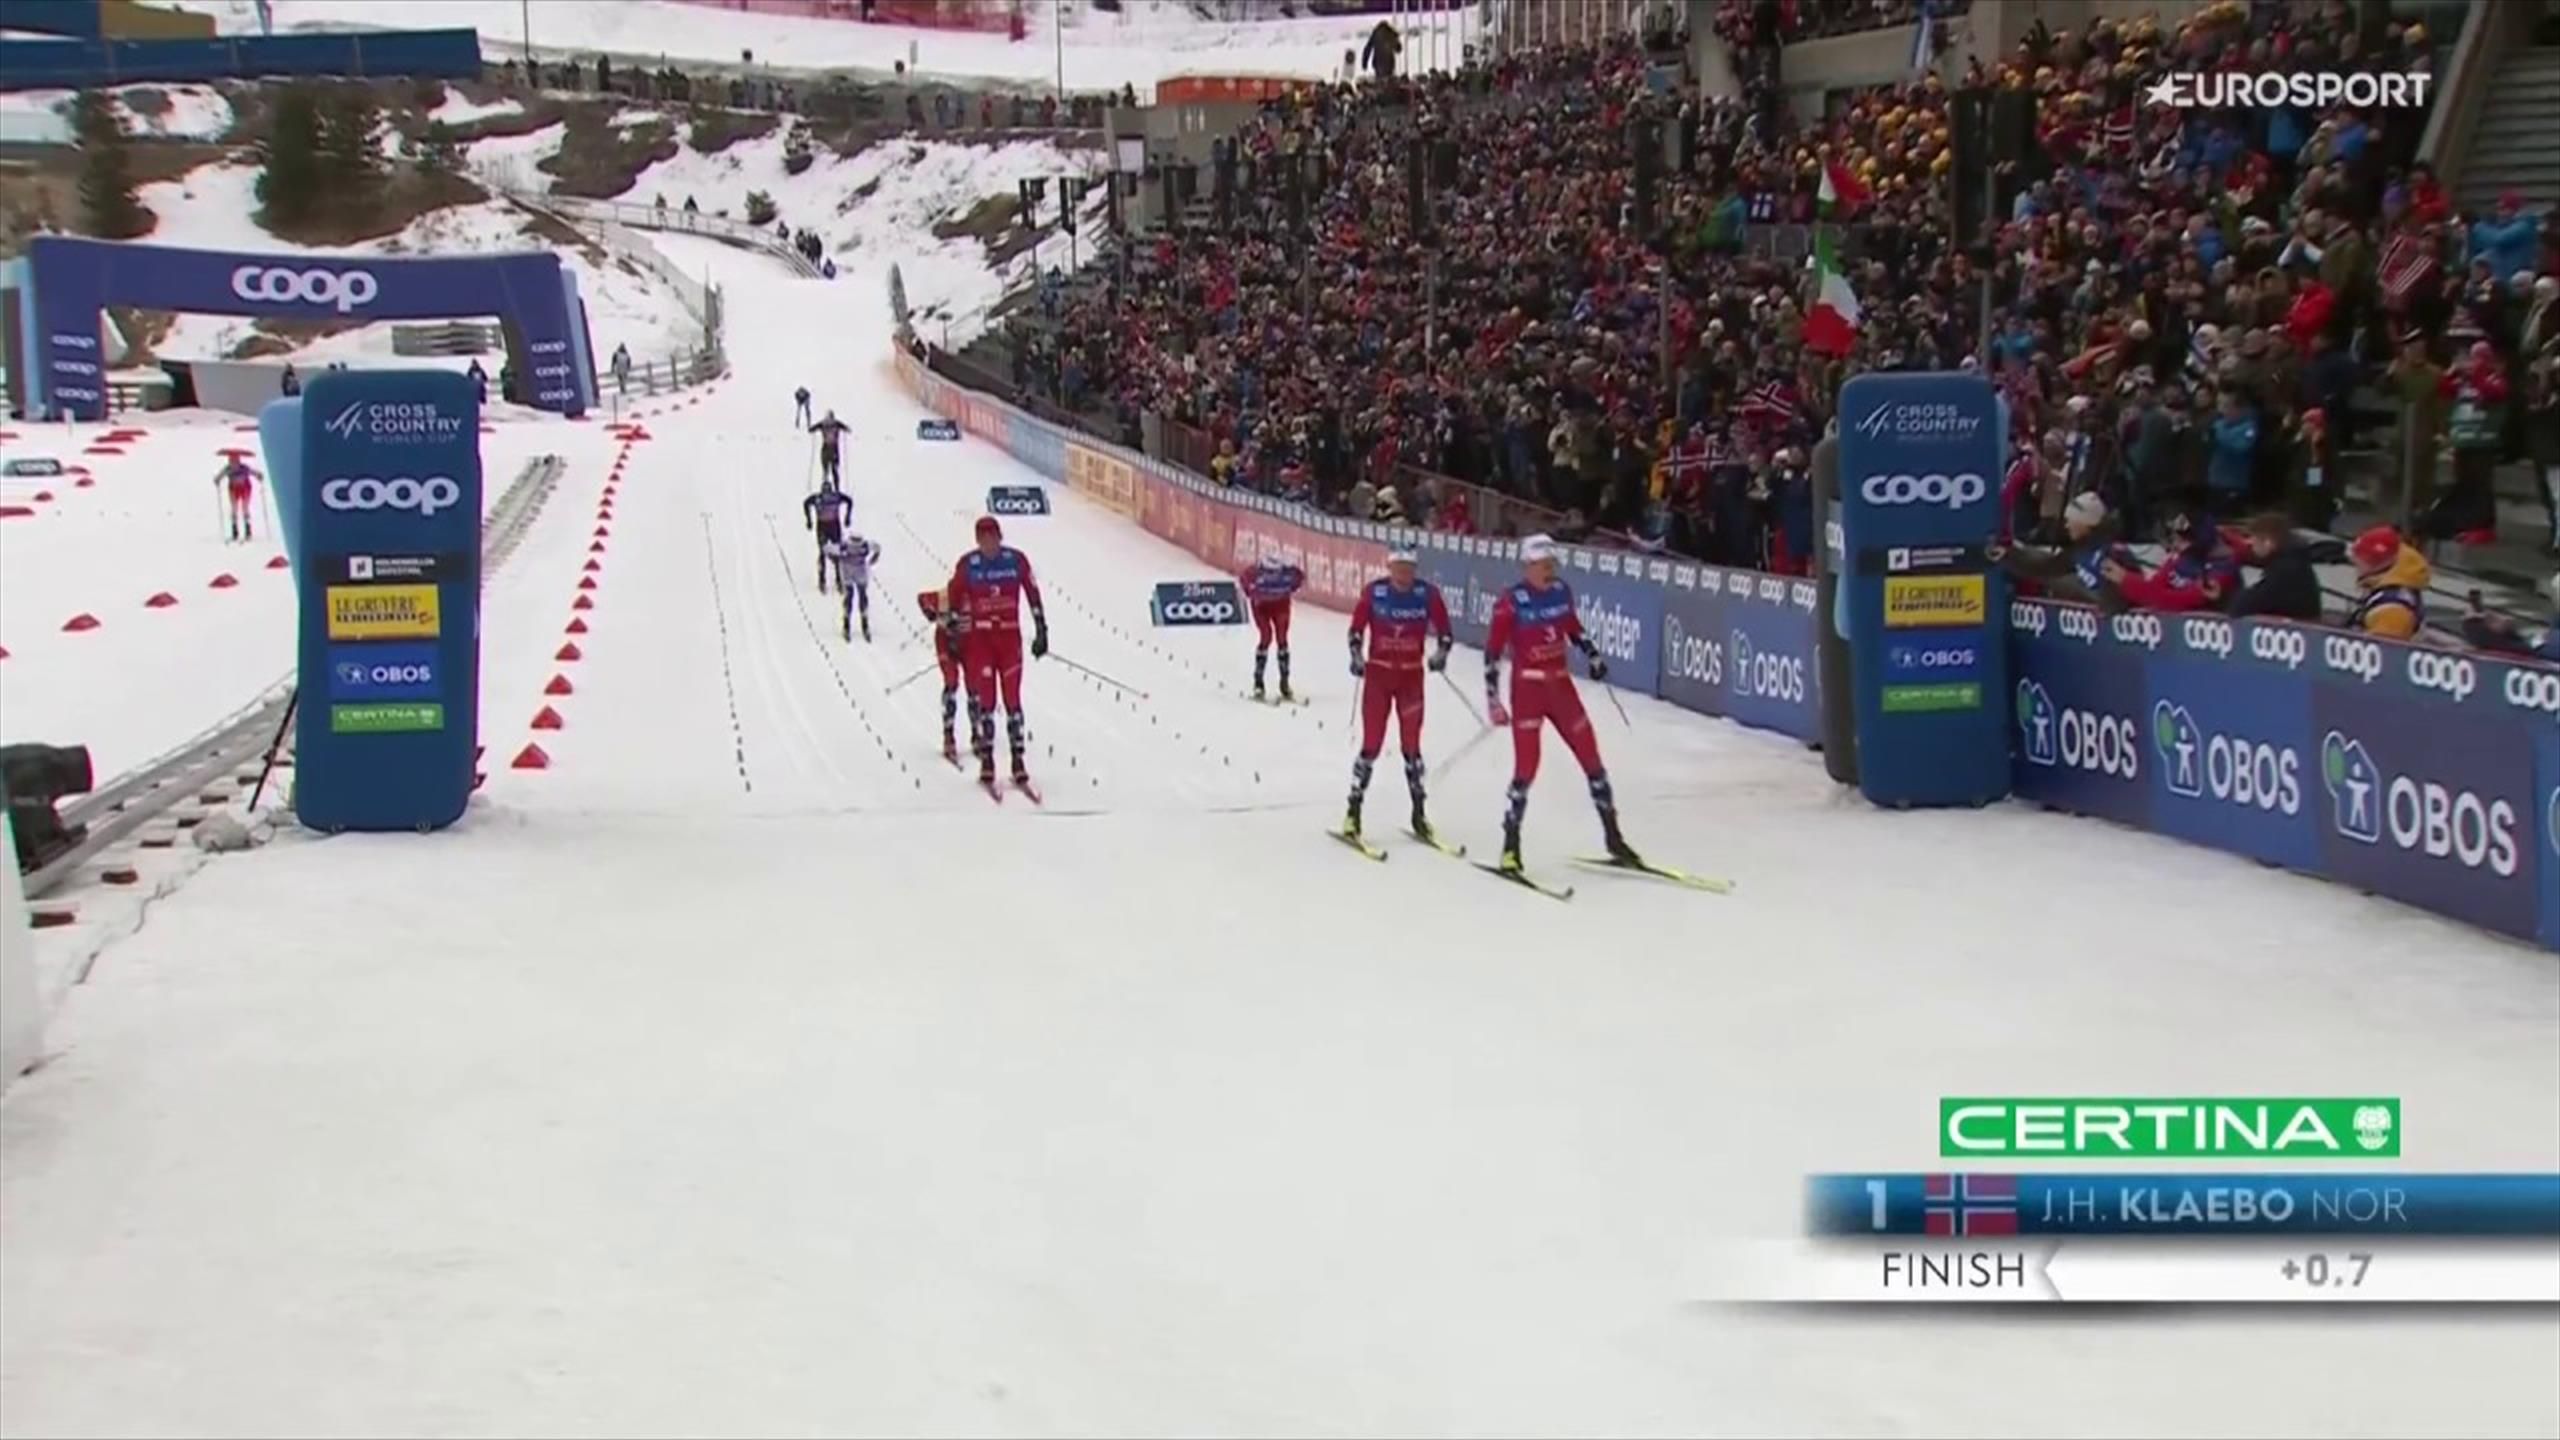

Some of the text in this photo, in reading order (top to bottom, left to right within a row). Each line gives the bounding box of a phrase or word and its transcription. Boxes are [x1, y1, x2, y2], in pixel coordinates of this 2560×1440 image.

[232, 266, 378, 312] coop
[369, 404, 437, 418] CROSS
[1896, 405, 1958, 418] CROSS
[370, 418, 461, 433] COUNTRY
[1896, 417, 1981, 432] COUNTRY
[321, 477, 460, 515] coop
[1861, 473, 1986, 509] coop
[996, 499, 1041, 515] coop
[1183, 584, 1216, 596] 25m
[1650, 561, 1671, 586] coop
[1675, 565, 1696, 591] coop
[1701, 569, 1721, 594] coop
[1728, 574, 1752, 601] coop
[1759, 579, 1784, 606] coop
[1791, 583, 1817, 613] coop
[336, 598, 350, 612] LE
[1164, 601, 1234, 622] coop
[1545, 625, 1557, 641] 3
[1683, 637, 1722, 684] OBOS
[1921, 649, 1975, 666] OBOS
[2011, 602, 2560, 713] coop coop coop coop coop coop coop coo
[371, 666, 431, 683] OBOS
[1754, 652, 1804, 703] OBOS
[339, 710, 416, 722] CERTINA
[2059, 708, 2138, 779] OBOS
[2207, 735, 2300, 817] OBOS
[2388, 775, 2517, 877] OBOS
